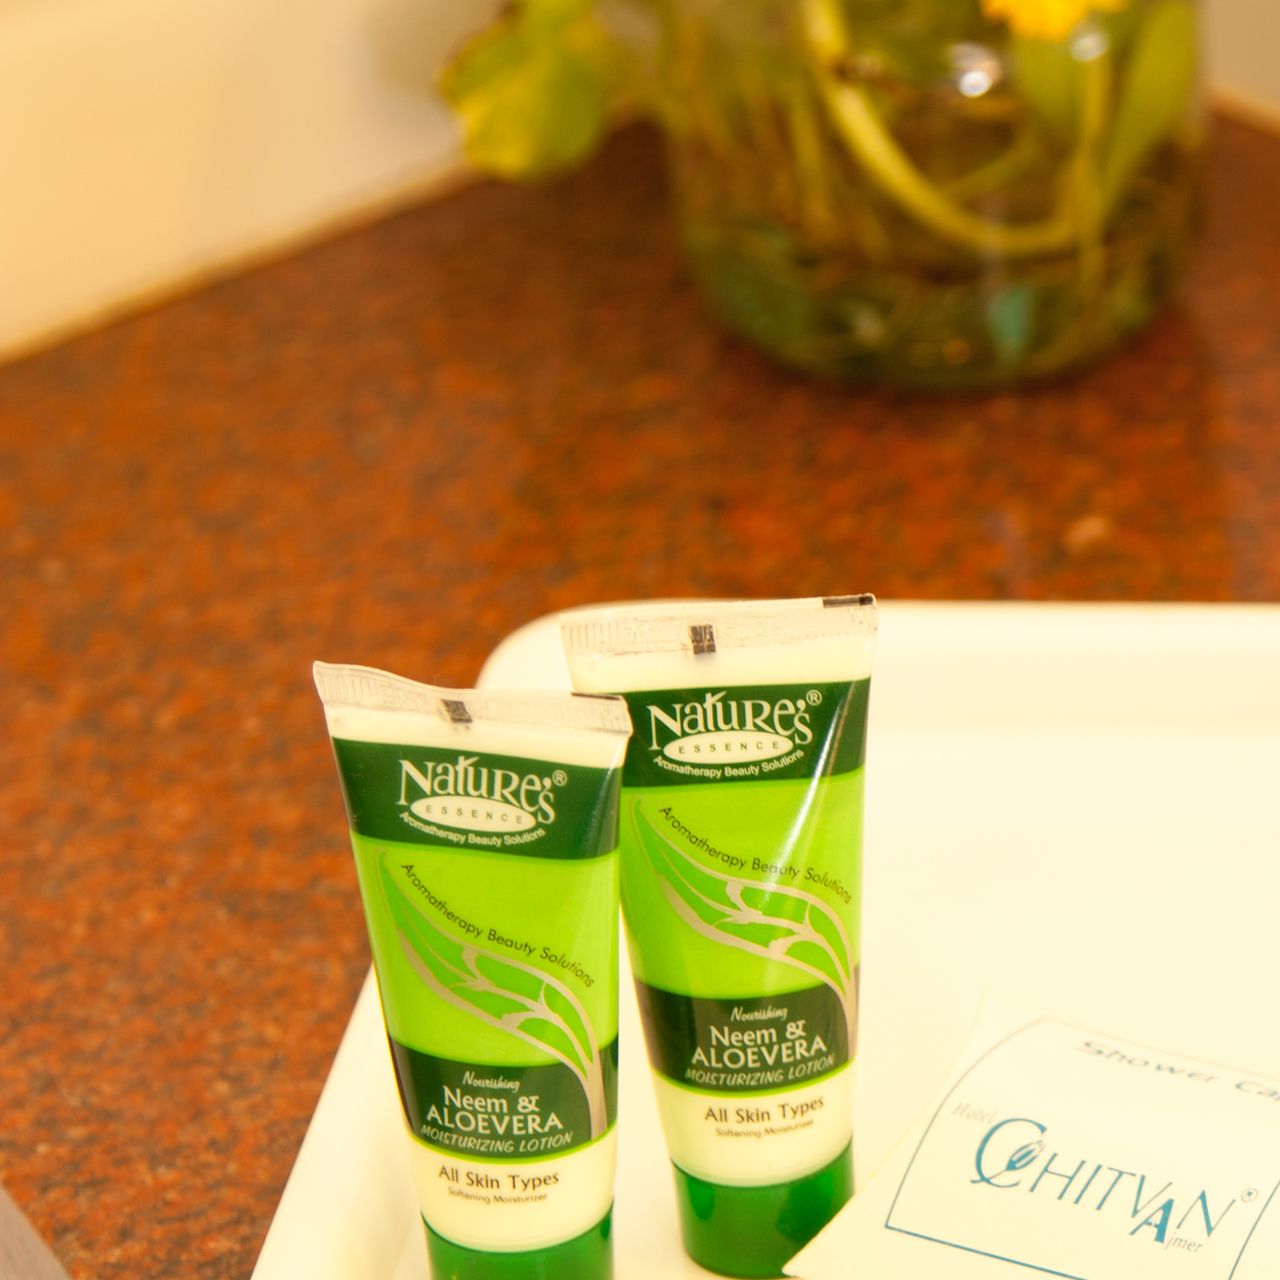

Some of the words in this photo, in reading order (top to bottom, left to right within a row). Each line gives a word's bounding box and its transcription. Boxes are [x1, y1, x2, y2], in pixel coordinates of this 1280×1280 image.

[678, 741, 779, 754] ESSENCE
[654, 754, 722, 779] Aromatherapy
[724, 765, 760, 777] Beauty
[762, 749, 804, 772] Solutions
[425, 804, 523, 824] ESSENCE
[400, 811, 466, 843] Aromatherapy
[468, 832, 502, 847] Beauty
[504, 828, 546, 845] Solutions
[659, 806, 748, 870] Aromatherapy
[751, 858, 800, 880] Beauty
[804, 868, 852, 904] Solutions
[401, 863, 484, 938] Aromatherapy
[488, 929, 536, 957] Beauty
[540, 947, 595, 988] Solutions
[731, 1006, 788, 1021] Nourishing
[709, 1026, 777, 1048] Neem
[786, 1020, 806, 1039] &
[691, 1036, 827, 1068] ALOEVERA
[1080, 1041, 1219, 1082] Shower
[462, 1071, 520, 1092] Nourishing
[685, 1068, 783, 1086] MOISTURIZING
[788, 1054, 835, 1078] LOTION
[443, 1086, 507, 1112] Neem
[516, 1095, 540, 1113] &
[704, 1106, 727, 1122] All
[735, 1108, 770, 1123] Skin
[779, 1097, 824, 1121] Types
[426, 1104, 563, 1136] ALOEVERA
[420, 1124, 514, 1153] MOISTURIZING
[519, 1131, 573, 1152] LOTION
[438, 1165, 458, 1183] All
[466, 1172, 500, 1190] Skin
[508, 1172, 559, 1191] Types
